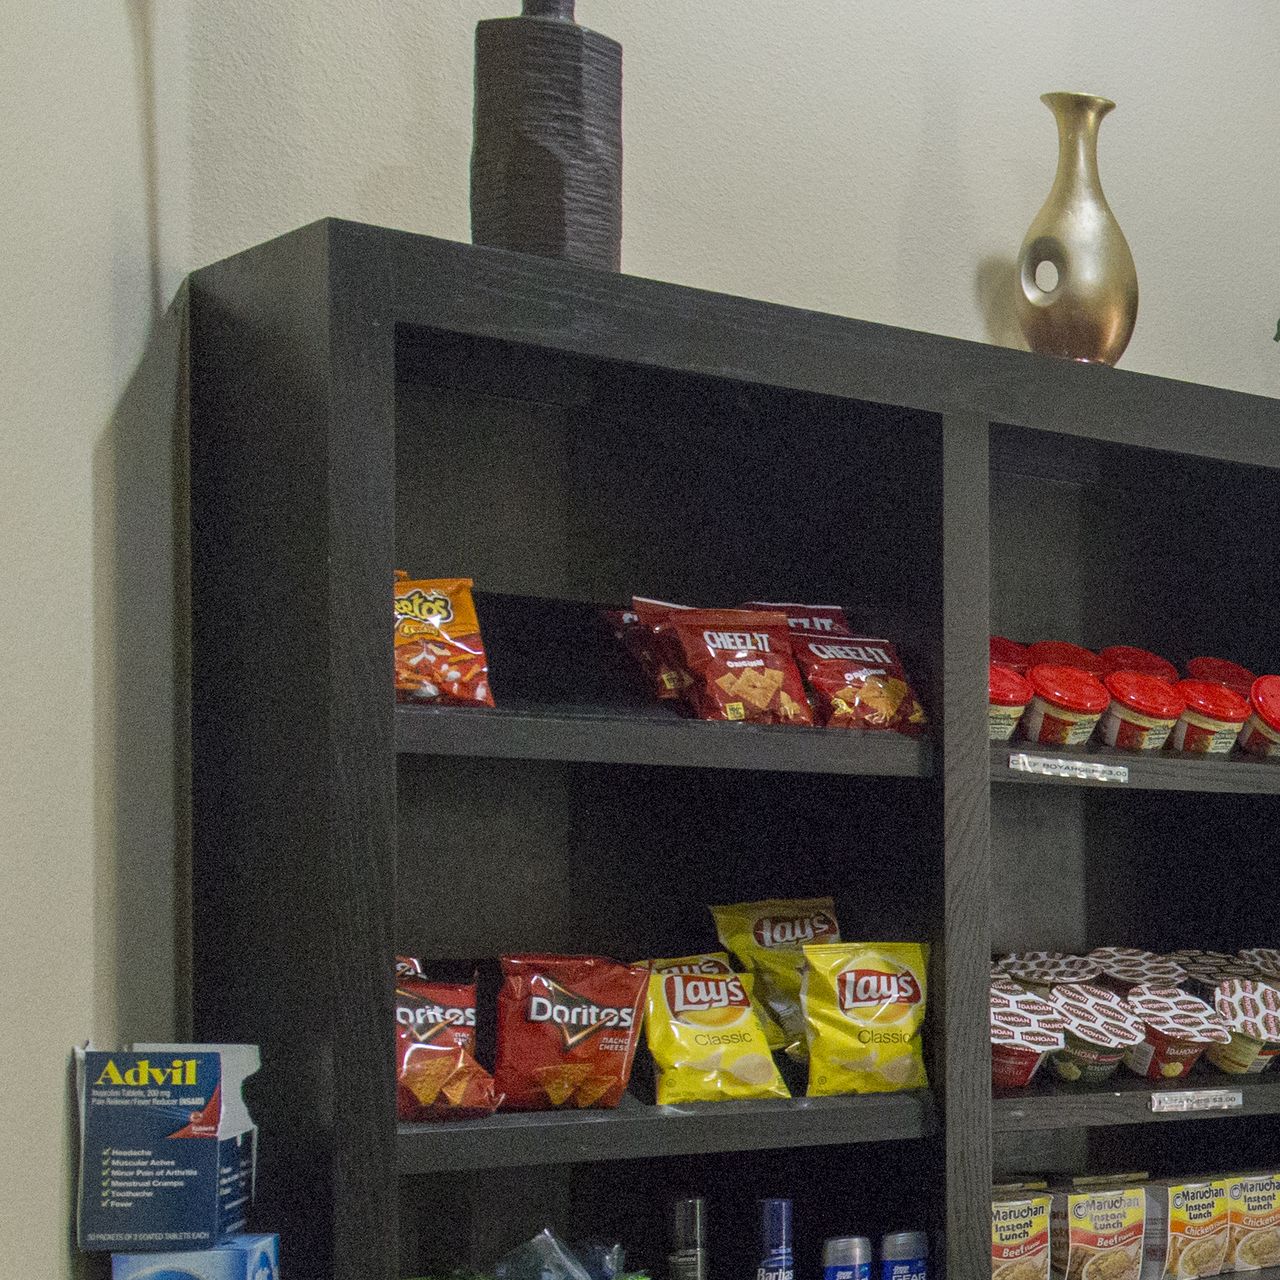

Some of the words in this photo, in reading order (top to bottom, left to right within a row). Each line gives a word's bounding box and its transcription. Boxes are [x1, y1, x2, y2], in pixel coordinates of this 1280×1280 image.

[396, 594, 450, 620] etos
[763, 914, 829, 947] Lay's
[674, 975, 744, 1012] Lay's
[844, 970, 914, 1010] Lay's
[530, 996, 633, 1027] Doritos
[995, 1014, 1031, 1025] IDAHOAN
[1039, 1021, 1064, 1030] IDAHO
[694, 1032, 753, 1047] Classic
[857, 1029, 912, 1046] Classic
[1022, 1033, 1059, 1044] IDAHOAN
[95, 1058, 198, 1086] Advil
[111, 1159, 149, 1167] Muscular
[111, 1169, 135, 1177] Minor
[156, 1169, 164, 1177] of
[165, 1168, 198, 1177] Arthritis
[111, 1180, 151, 1188] Menstrual
[1182, 1187, 1225, 1201] Maruchan
[1243, 1192, 1277, 1204] Instant
[1087, 1197, 1140, 1211] Maruchan
[1185, 1202, 1215, 1213] Instant
[1247, 1202, 1273, 1212] Lunch
[1090, 1211, 1127, 1223] Instant
[1188, 1211, 1212, 1221] Lunch
[1242, 1216, 1275, 1229] Chicken
[995, 1219, 1033, 1233] Instant
[1094, 1220, 1123, 1231] Lunch
[1184, 1222, 1215, 1236] Chicken
[1000, 1230, 1030, 1242] Lunch
[1097, 1234, 1118, 1247] Beef
[1002, 1245, 1026, 1258] Beef
